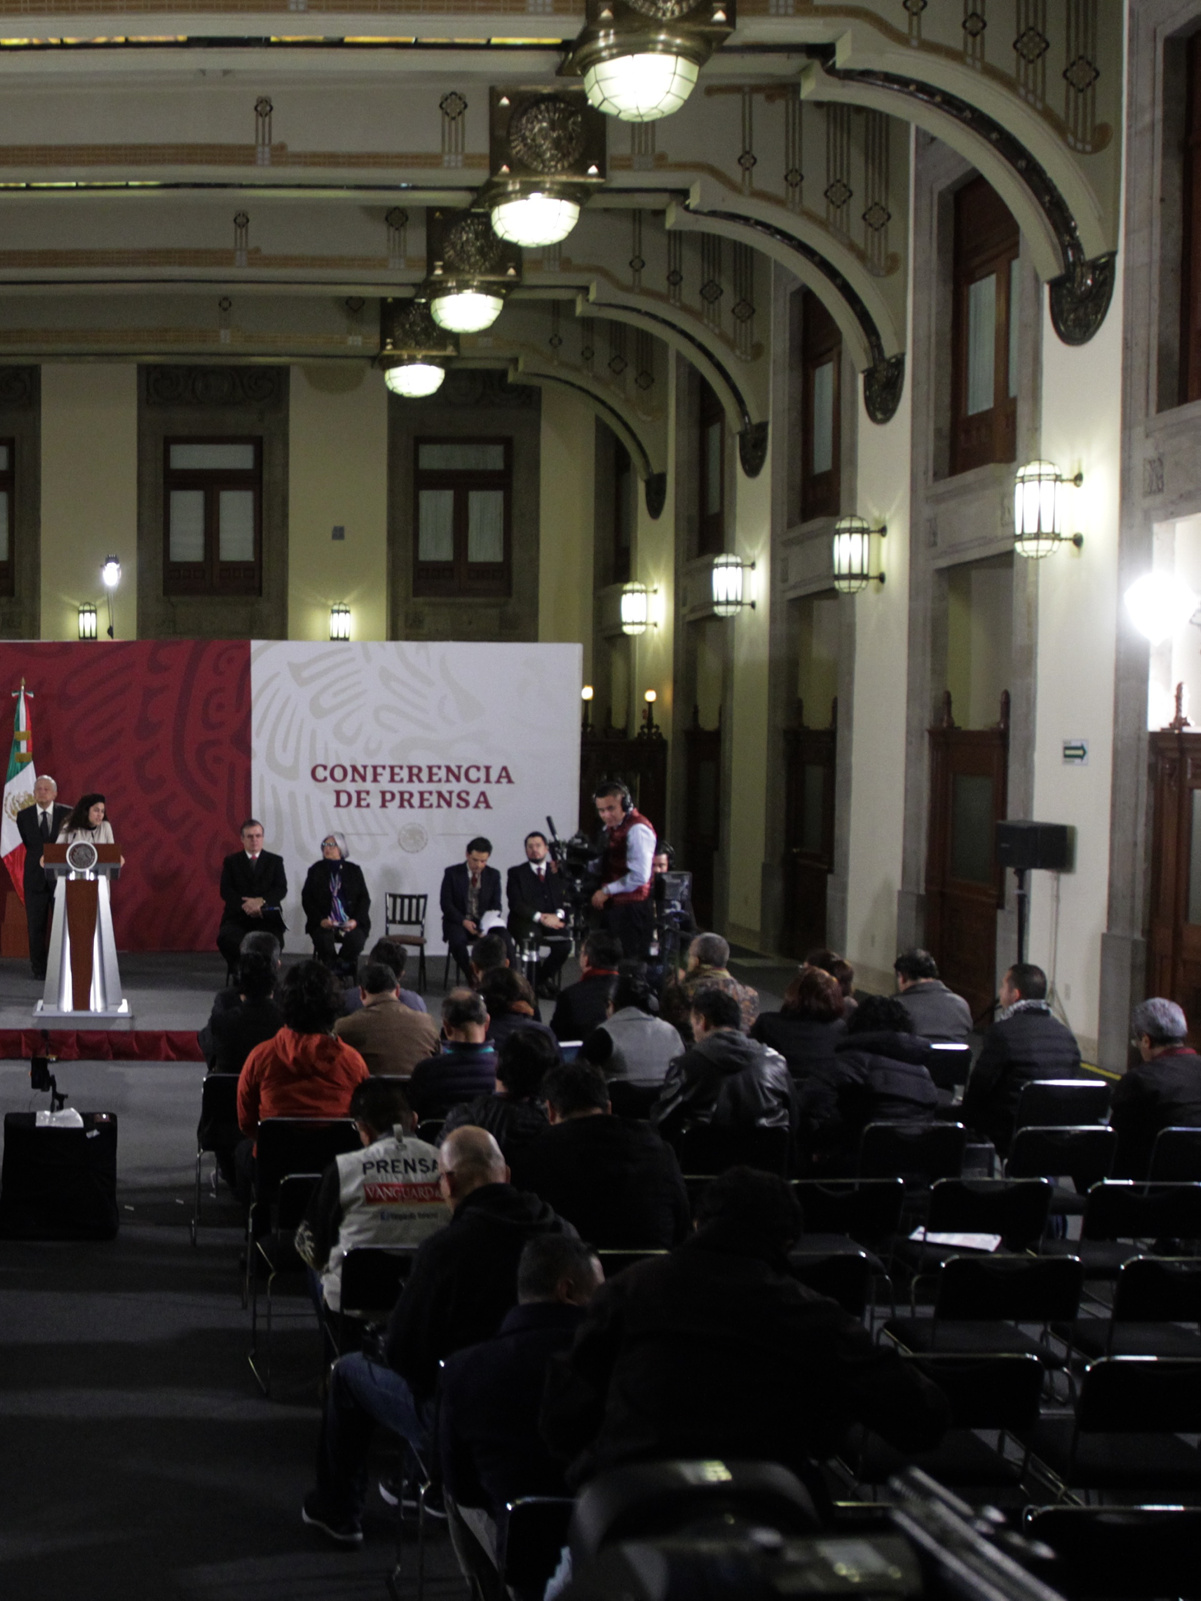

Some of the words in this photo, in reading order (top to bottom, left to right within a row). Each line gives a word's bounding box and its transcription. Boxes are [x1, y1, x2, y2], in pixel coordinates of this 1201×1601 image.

[310, 763, 515, 785] CONFERENCIA
[333, 789, 371, 809] DE
[379, 789, 493, 809] PRENSA
